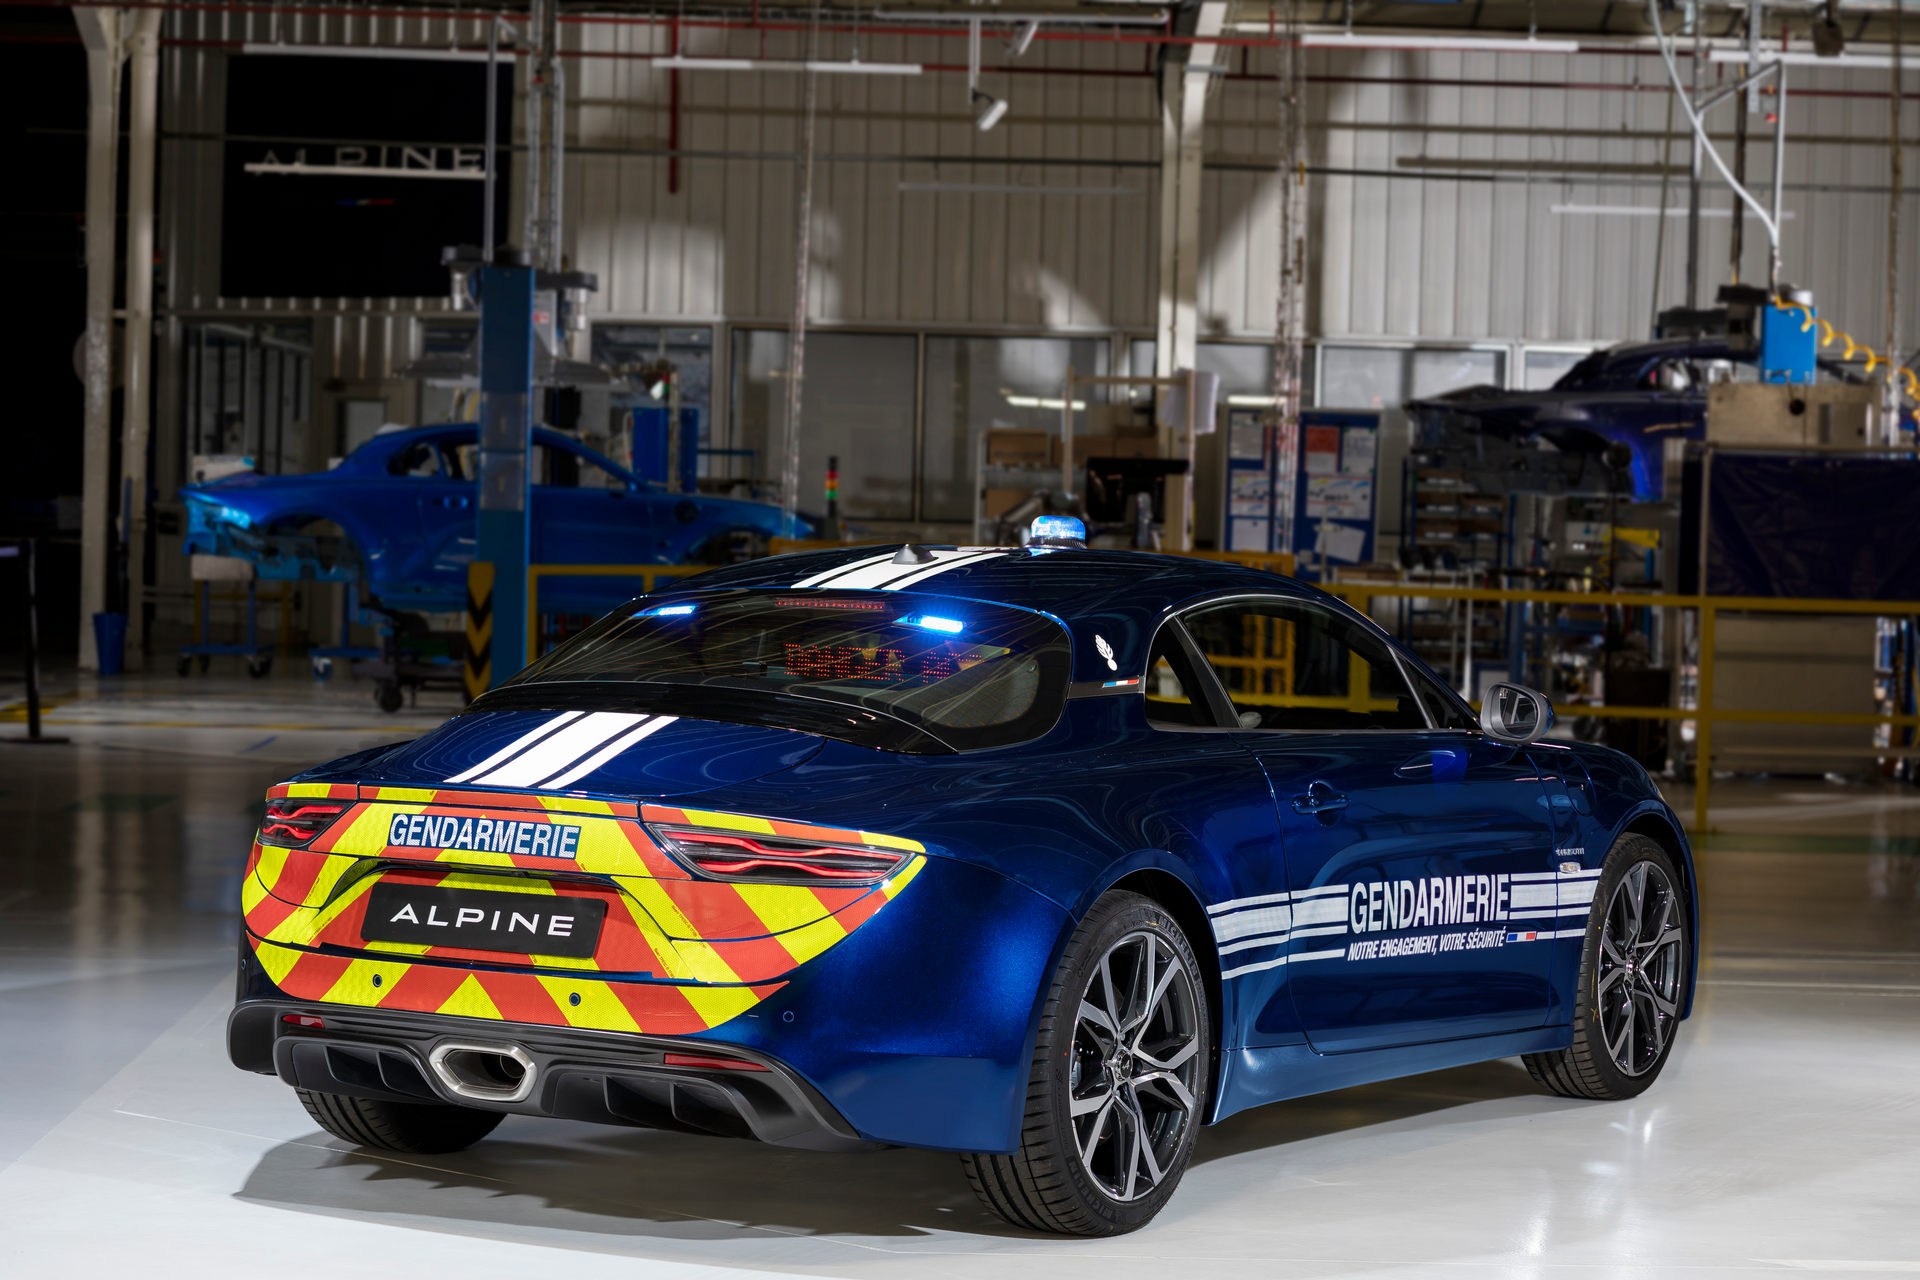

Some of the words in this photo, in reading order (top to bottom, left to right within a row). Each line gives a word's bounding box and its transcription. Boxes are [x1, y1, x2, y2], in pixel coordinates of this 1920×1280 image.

[389, 813, 579, 859] GENDARMERIE
[389, 903, 575, 938] ALPINE
[1349, 873, 1511, 935] GENDARMERIE
[1347, 940, 1379, 962] NOTRE
[1378, 935, 1439, 956] ENGAGEMENT,
[1439, 932, 1469, 952] VOTRE
[1466, 926, 1506, 950] SÉCURITÉ
